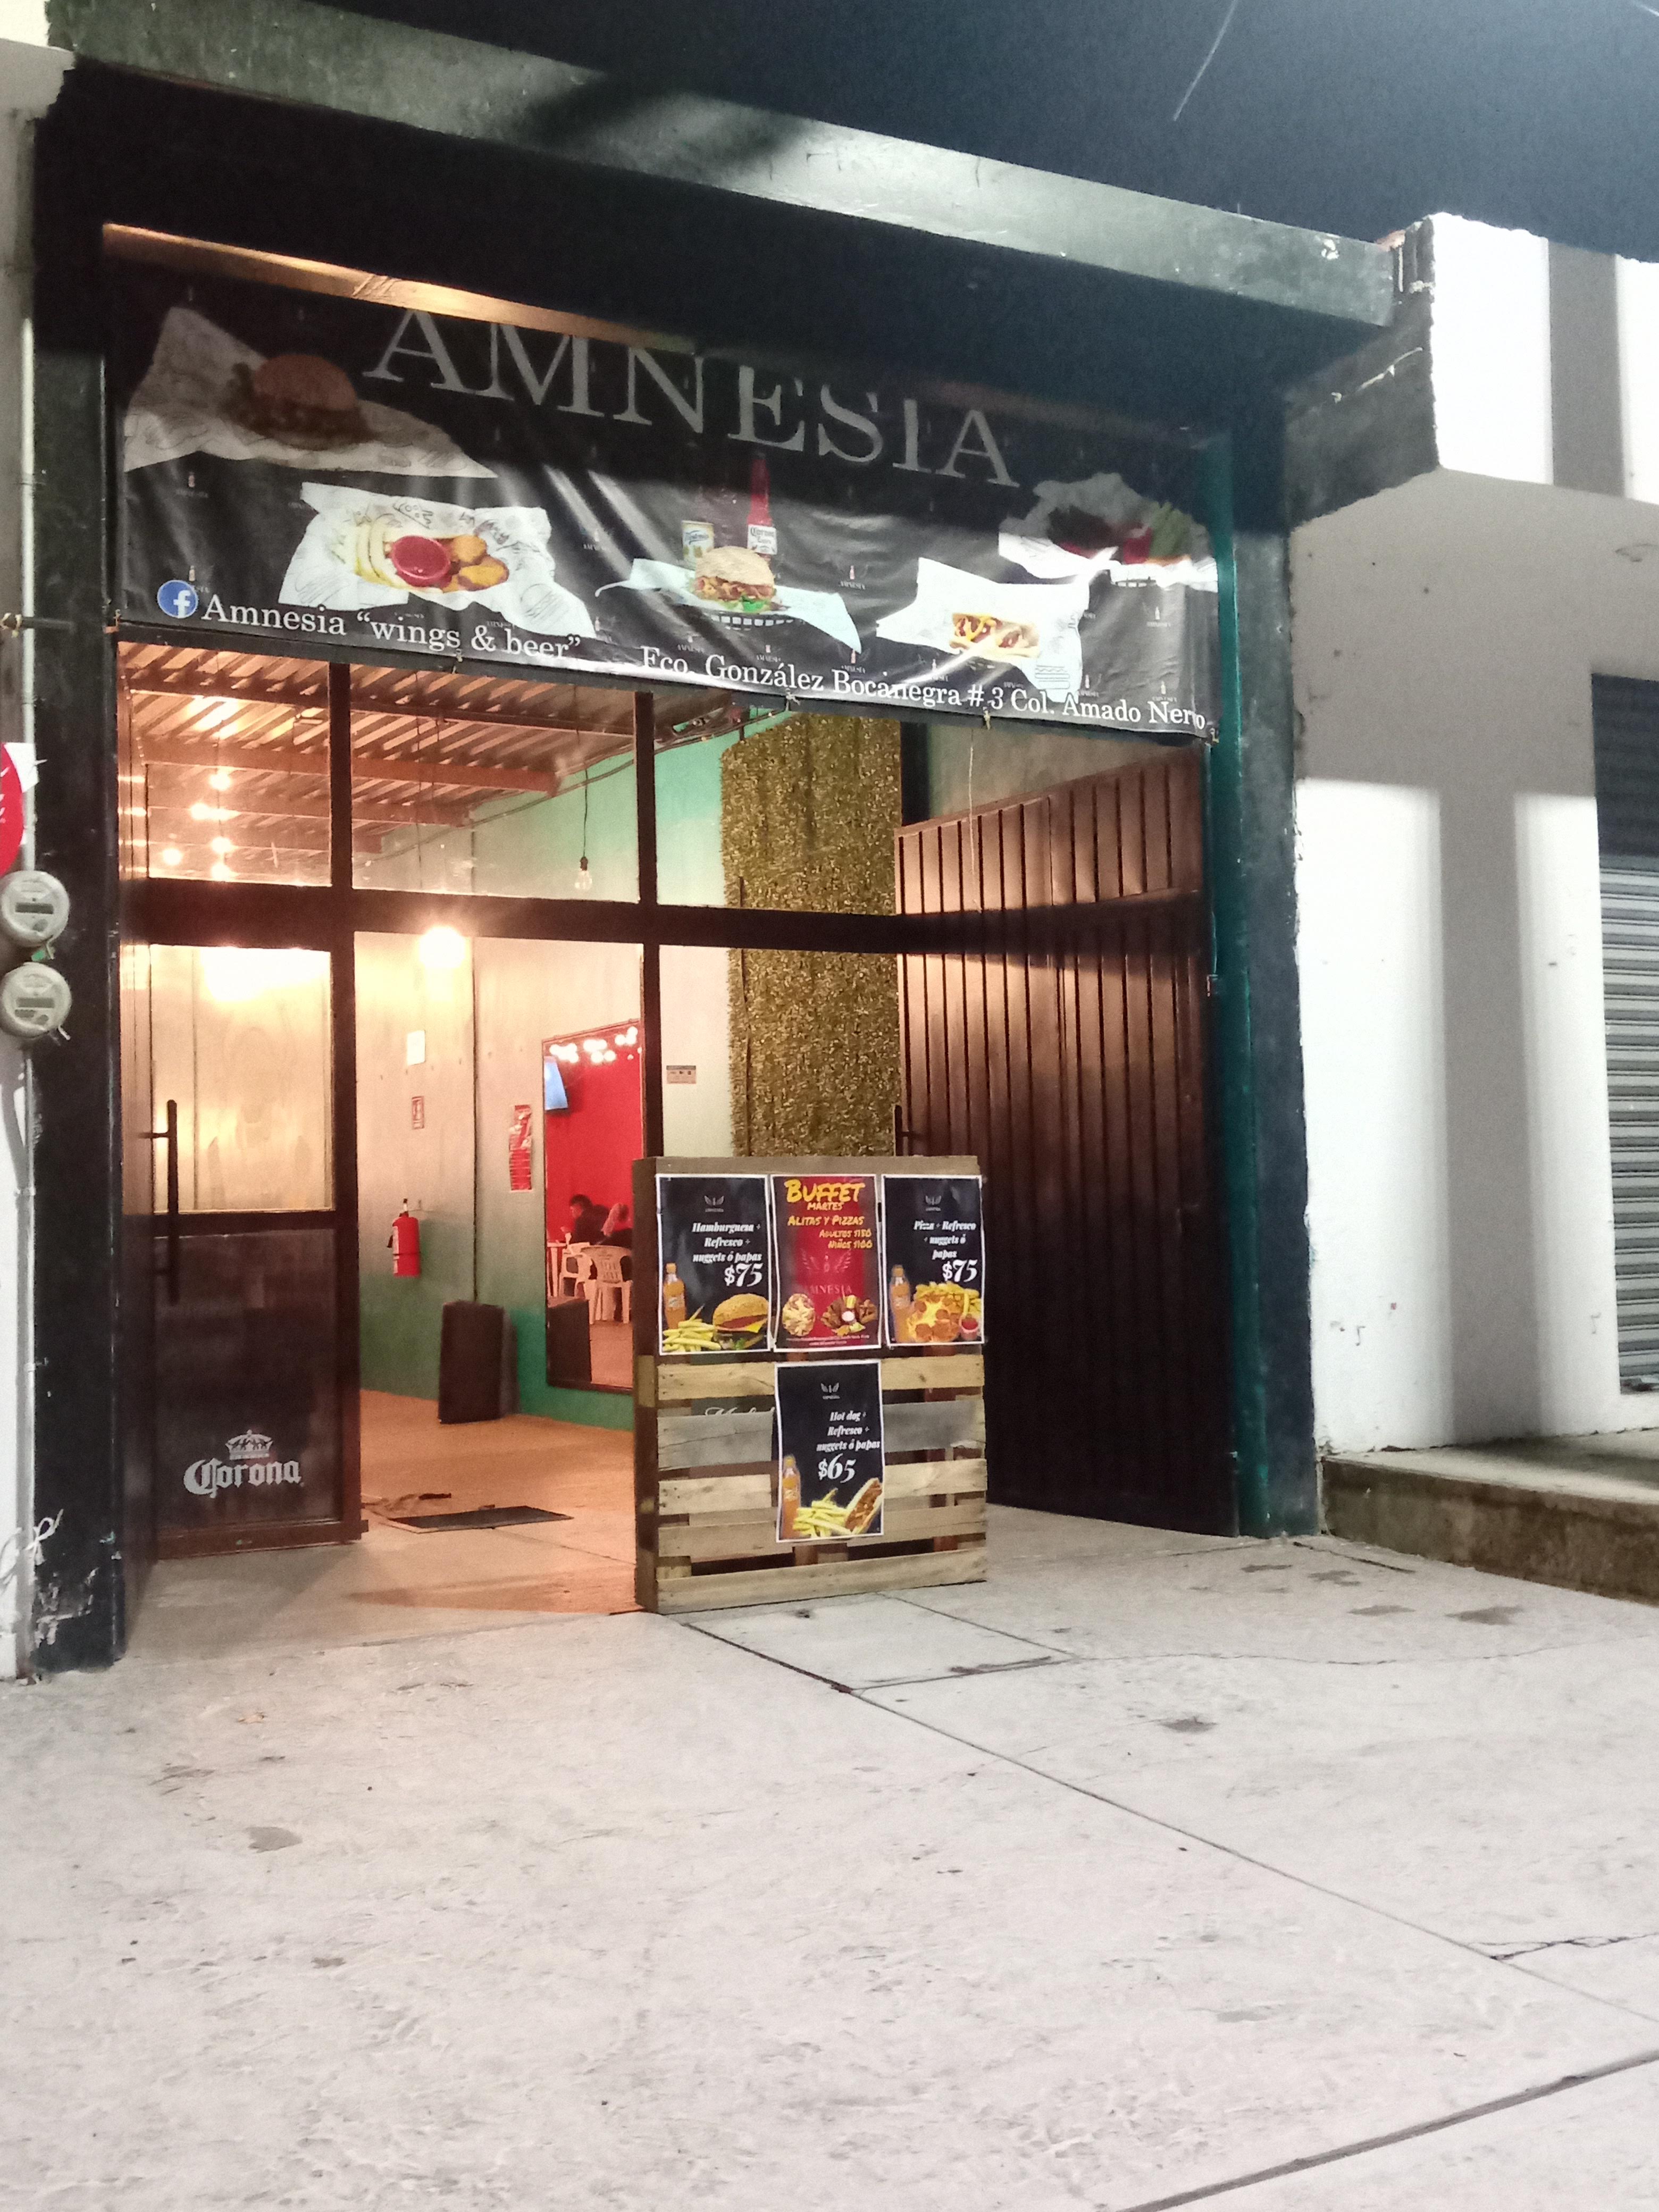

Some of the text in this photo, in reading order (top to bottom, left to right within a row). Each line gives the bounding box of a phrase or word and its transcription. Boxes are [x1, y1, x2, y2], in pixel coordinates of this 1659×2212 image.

[362, 309, 1020, 488] AMNESIA
[201, 594, 346, 636] Amnesia
[471, 625, 496, 652] &
[706, 654, 825, 691] González
[831, 668, 962, 707] Bocanegra
[968, 684, 985, 707] #
[991, 686, 1004, 710] 3
[1010, 689, 1054, 715] Col.
[1062, 692, 1141, 723] Amado
[784, 1179, 866, 1203] BUFFET
[807, 1202, 844, 1211] MARTES
[692, 1222, 755, 1234] Hamburguesa
[914, 1220, 935, 1230] Pizza
[942, 1220, 976, 1231] Refresco
[704, 1237, 743, 1249] Refresco
[929, 1235, 959, 1246] nuggets
[693, 1253, 726, 1264] nuggets
[734, 1252, 762, 1263] papas
[932, 1250, 957, 1260] papas
[724, 1262, 764, 1287] $75
[942, 1259, 977, 1283] $75
[830, 1411, 845, 1422] Hot
[846, 1410, 861, 1422] dog
[827, 1425, 862, 1437] Refresco
[816, 1440, 847, 1453] nuggets
[855, 1439, 881, 1452] papas
[818, 1453, 856, 1484] $65
[183, 1457, 303, 1498] Corona
